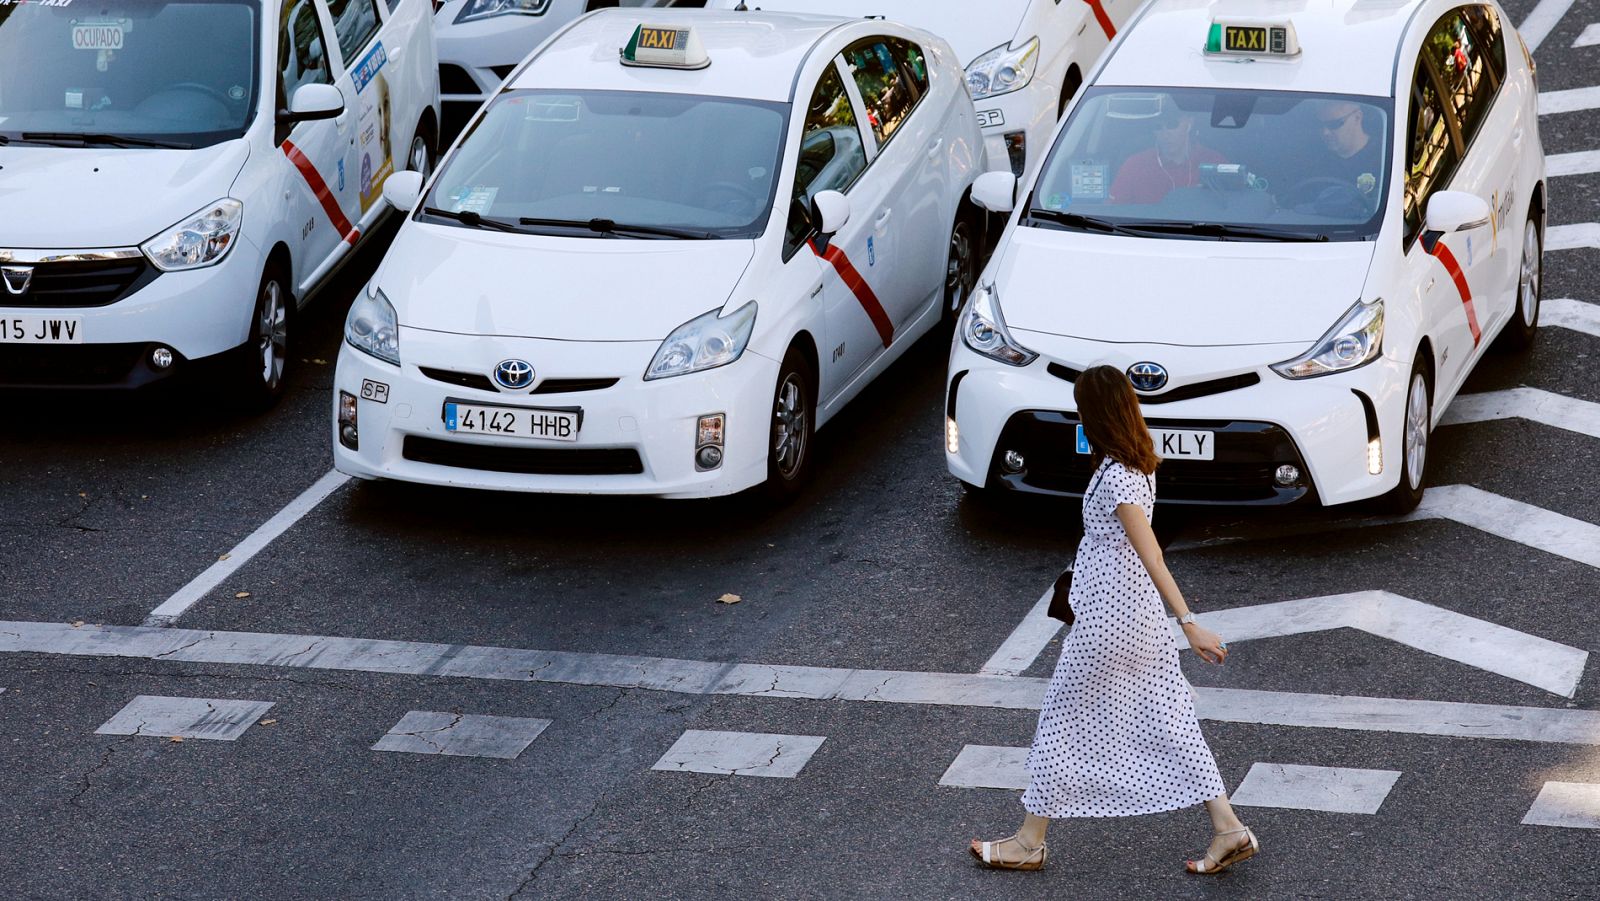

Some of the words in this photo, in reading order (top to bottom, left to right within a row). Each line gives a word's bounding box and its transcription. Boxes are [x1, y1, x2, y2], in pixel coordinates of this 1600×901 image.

[75, 28, 121, 47] OCUPADO
[641, 29, 676, 49] TAXI
[1227, 29, 1265, 49] TAXI
[976, 111, 999, 126] SP
[0, 319, 25, 340] 15
[34, 320, 77, 340] JWV
[363, 382, 387, 399] SP
[462, 409, 516, 433] 4142
[531, 414, 571, 438] HHB
[1162, 432, 1207, 455] KLY
